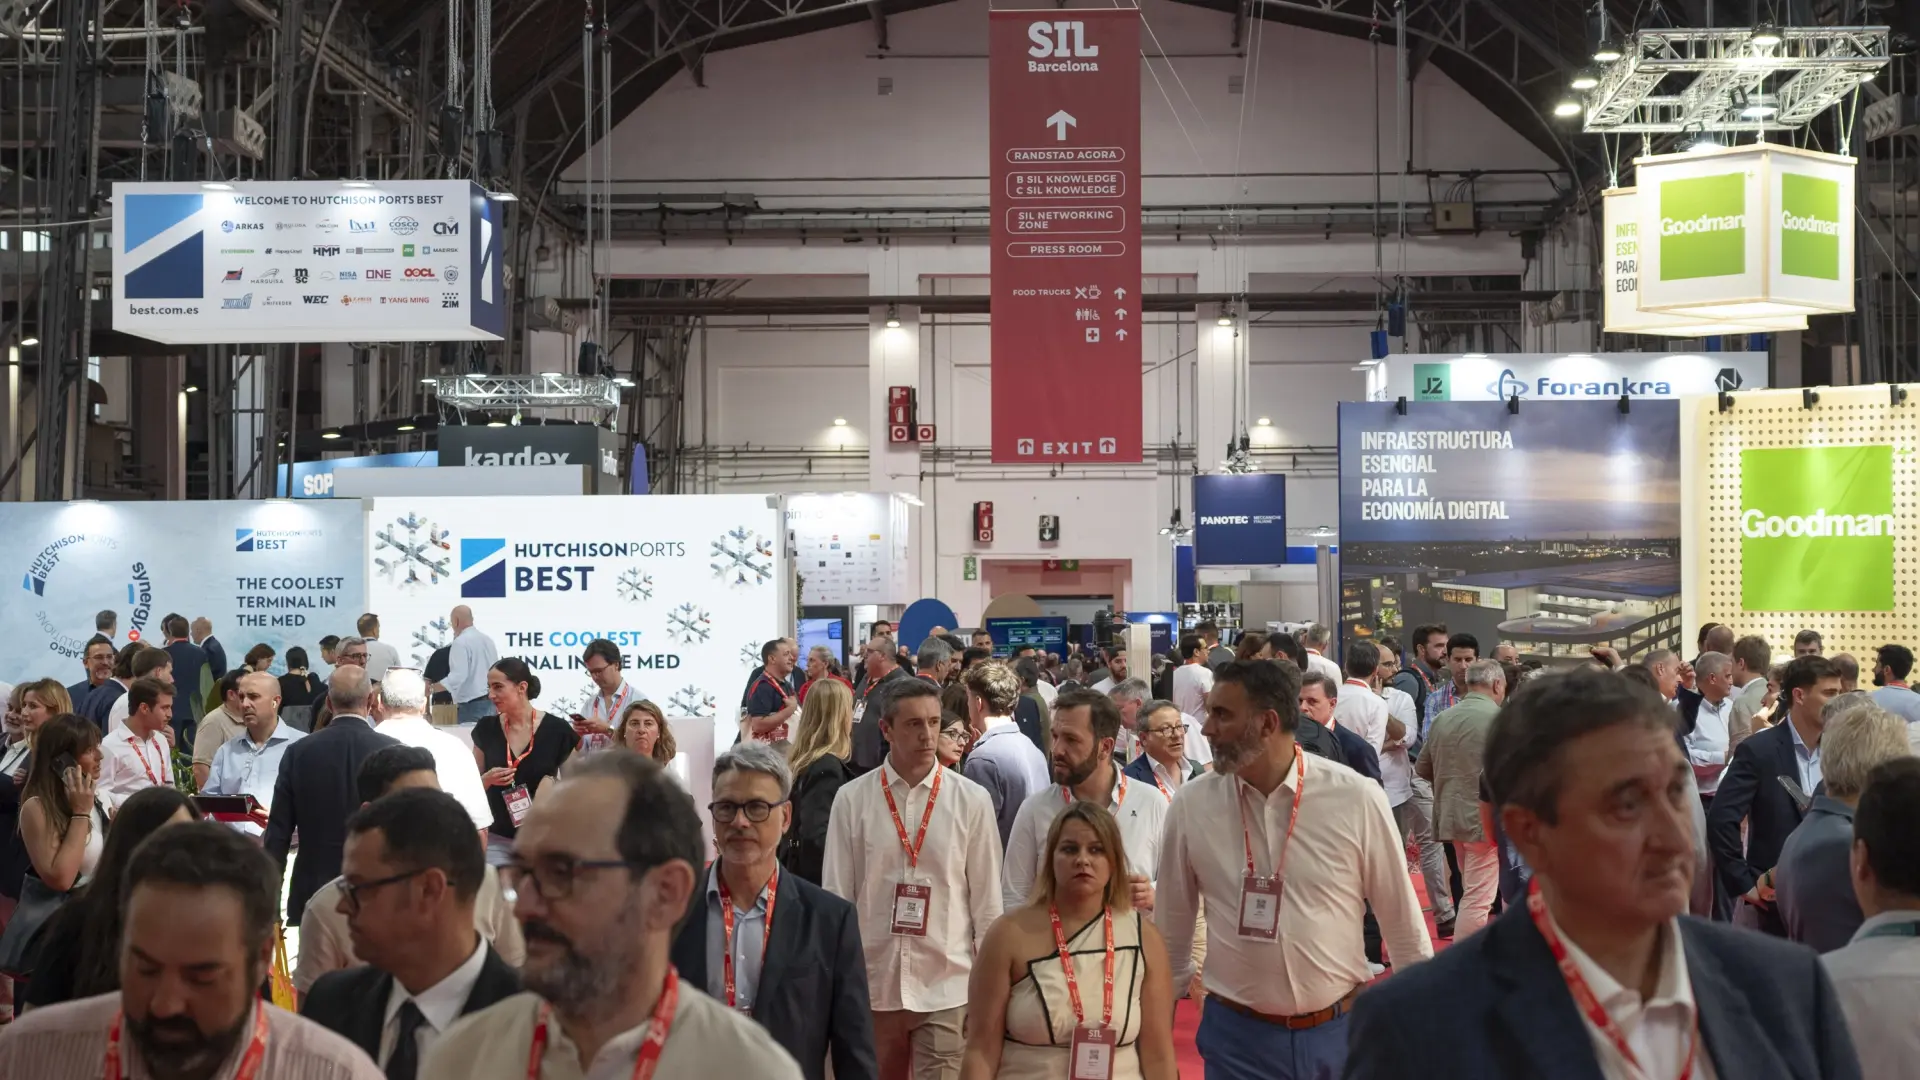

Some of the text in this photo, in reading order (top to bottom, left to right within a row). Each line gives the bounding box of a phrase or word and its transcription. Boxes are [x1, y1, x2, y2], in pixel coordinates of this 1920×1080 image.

[1028, 21, 1098, 58] SIL
[1028, 60, 1098, 72] Barcelona
[1014, 150, 1117, 160] RANDSTAD AGORA
[1016, 175, 1117, 184] B SIL KNOWLEDGE
[1016, 186, 1117, 195] C SIL KNOWLEDGE
[234, 195, 444, 205] WELCOME TO HUTCHISON PORTS BEST
[1018, 211, 1114, 220] SIL NETWORKING
[1018, 221, 1049, 229] ZONE
[1660, 213, 1747, 237] Goodman
[1782, 210, 1840, 237] Goodman
[313, 247, 341, 257] HMM
[1030, 245, 1102, 254] PRESS ROOM
[366, 269, 392, 279] ONE
[404, 268, 435, 277] OOCL
[303, 295, 329, 304] WEC
[442, 300, 459, 308] ZIM
[130, 304, 199, 315] best.com.es
[1537, 376, 1670, 396] forankra
[1361, 431, 1514, 450] INFRAESTRUCTURA
[1042, 442, 1093, 455] EXIT
[465, 446, 569, 466] kardex
[1361, 455, 1437, 474] ESENCIAL
[1361, 478, 1428, 497] PARA LA
[1362, 497, 1510, 520] ECONOMÍA DIGITAL
[1200, 516, 1249, 525] PANOTEC
[1740, 508, 1895, 538] Goodman
[257, 540, 287, 550] BEST
[38, 553, 60, 580] BEST
[236, 577, 344, 590] THE COOLEST
[515, 566, 595, 591] BEST
[236, 596, 336, 608] TERMINAL IN
[236, 614, 306, 627] THE MED
[505, 632, 544, 647] THE
[638, 654, 680, 669] MED
[1088, 1030, 1102, 1038] SIL
